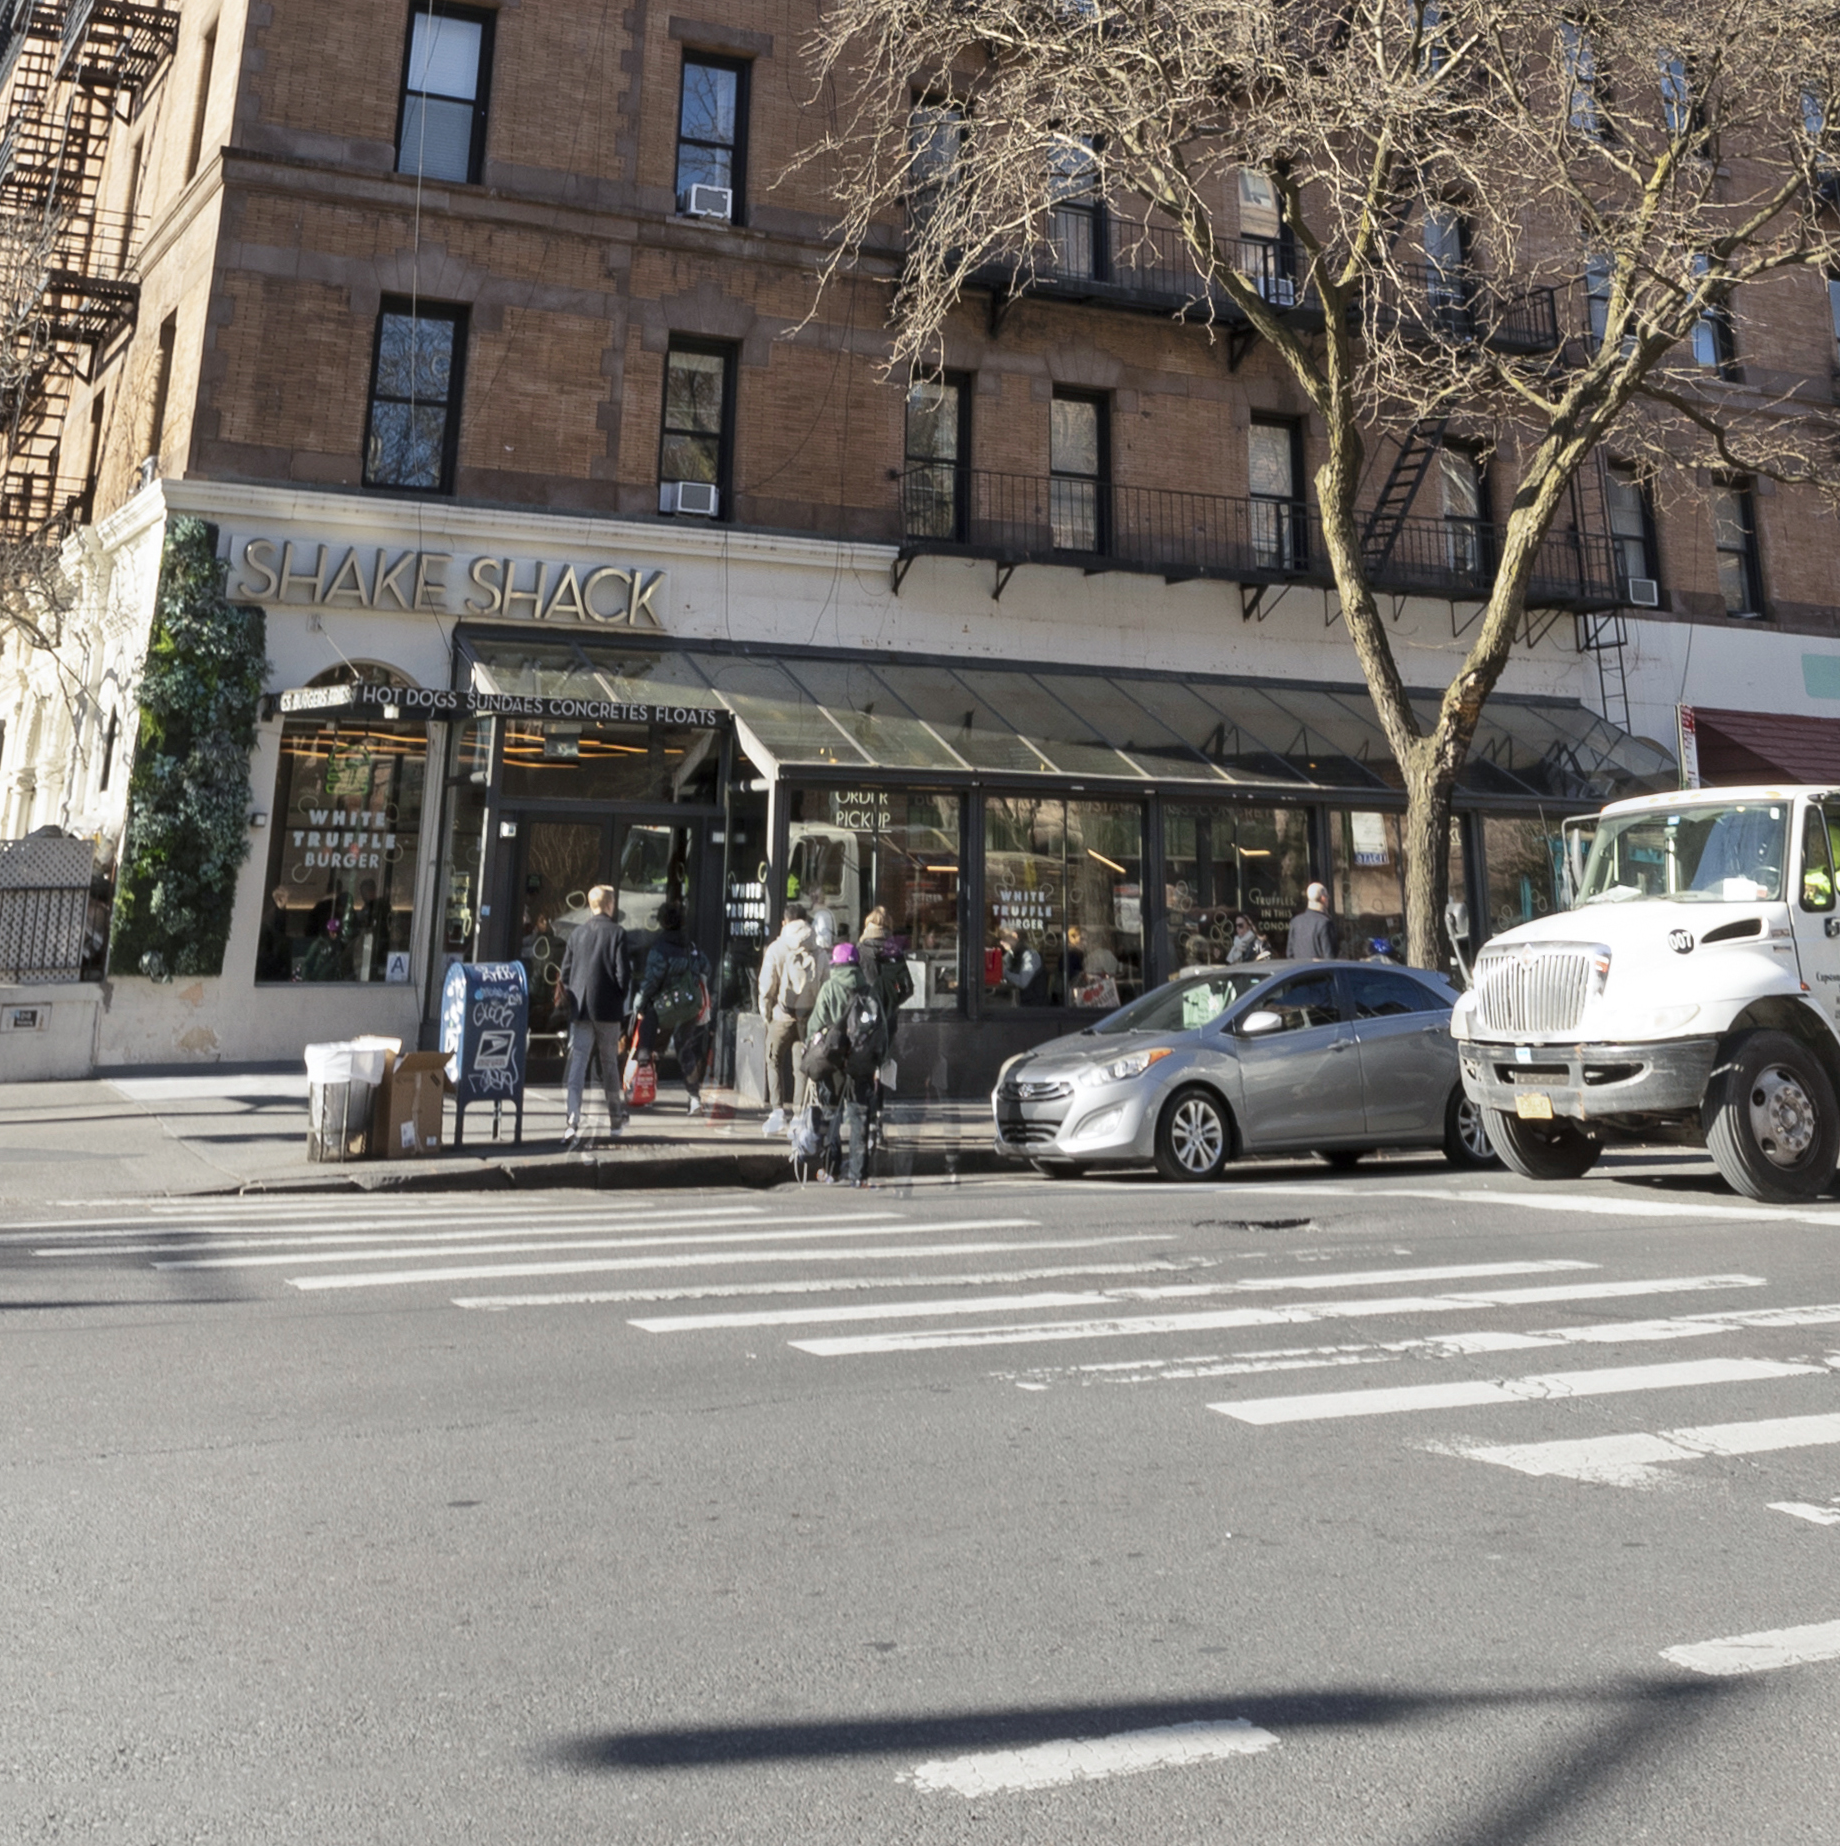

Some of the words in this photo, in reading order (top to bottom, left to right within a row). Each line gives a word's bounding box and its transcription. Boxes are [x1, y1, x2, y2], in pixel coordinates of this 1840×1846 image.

[238, 539, 454, 610] SHAKE
[464, 555, 667, 628] SHACK
[363, 686, 403, 704] HOT
[406, 688, 457, 708] DOGS
[466, 692, 543, 715] SUNDAES
[549, 699, 648, 721] CONCRETES
[655, 706, 716, 726] FLOATS
[308, 809, 386, 827] WHITE
[293, 831, 396, 849] TRUFFLE
[304, 852, 379, 868] BURGER
[1000, 891, 1045, 902] WHITE
[992, 905, 1052, 917] TRUFFLE
[1261, 909, 1272, 918] IN
[1274, 909, 1293, 918] THIS
[1668, 931, 1692, 950] 007
[391, 956, 404, 973] A
